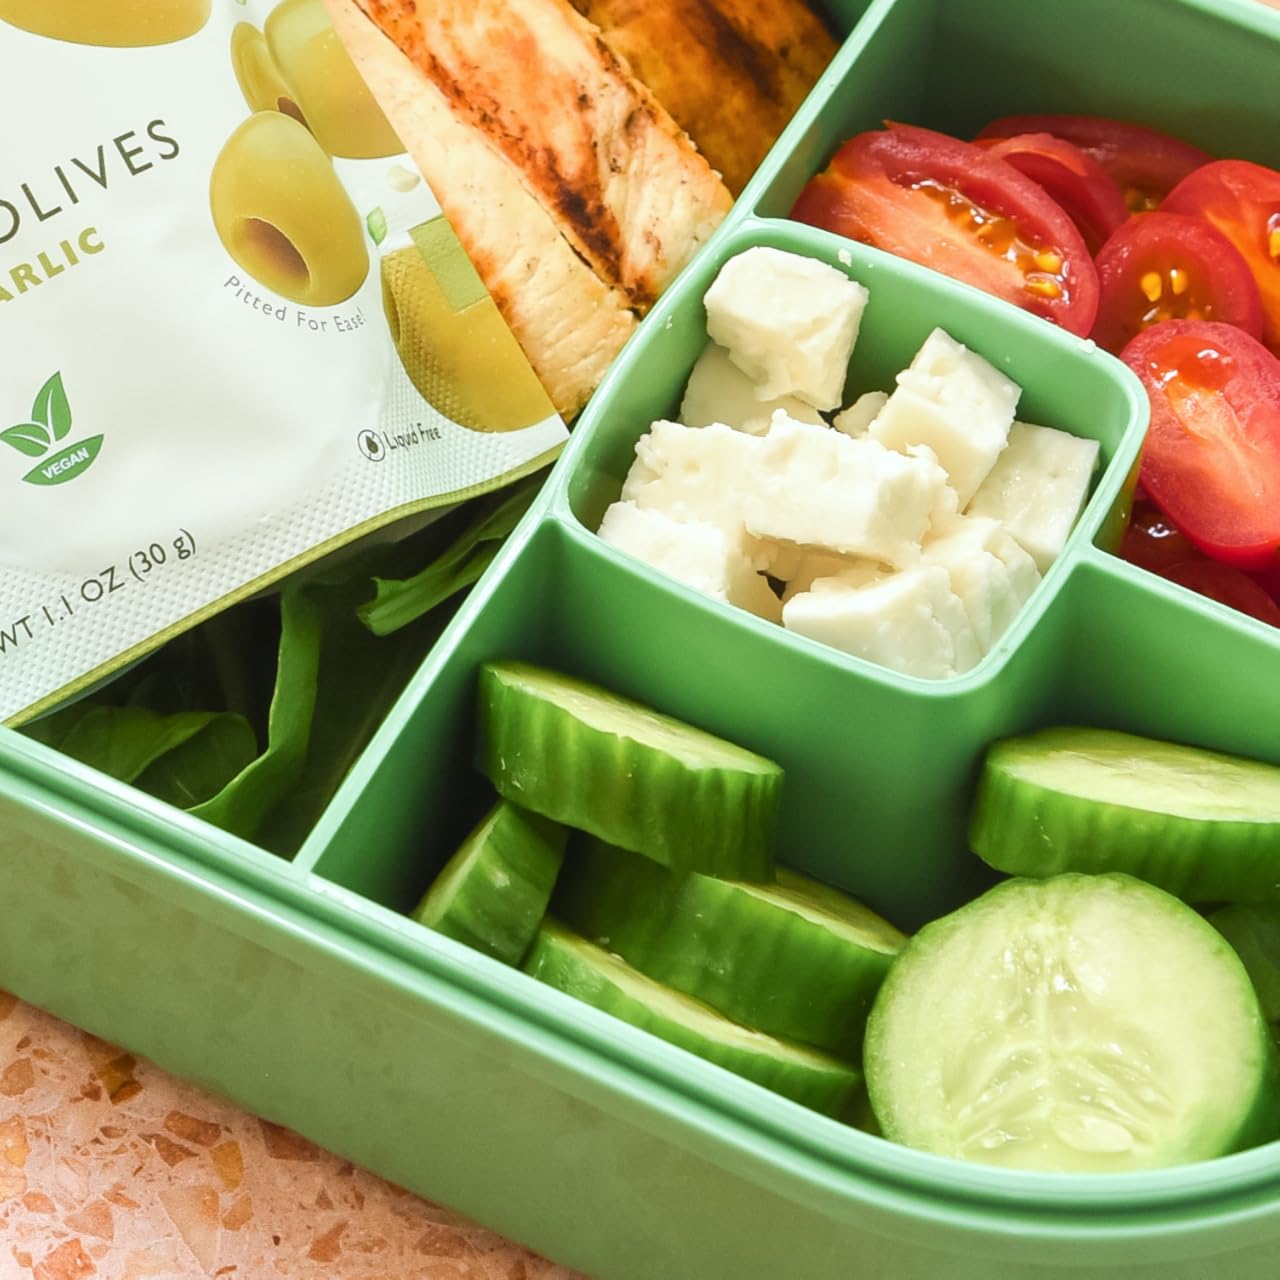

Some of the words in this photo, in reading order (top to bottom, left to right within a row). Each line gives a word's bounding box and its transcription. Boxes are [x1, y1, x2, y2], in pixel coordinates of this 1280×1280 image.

[223, 275, 287, 322] Pitted
[297, 311, 328, 332] For
[333, 305, 368, 333] Ease!
[382, 422, 419, 453] Liquid
[416, 422, 443, 443] Free
[42, 446, 90, 480] VEGAN
[42, 595, 74, 626] 1.1
[80, 566, 125, 602] OZ
[128, 543, 166, 582] (30
[173, 528, 196, 560] g)
